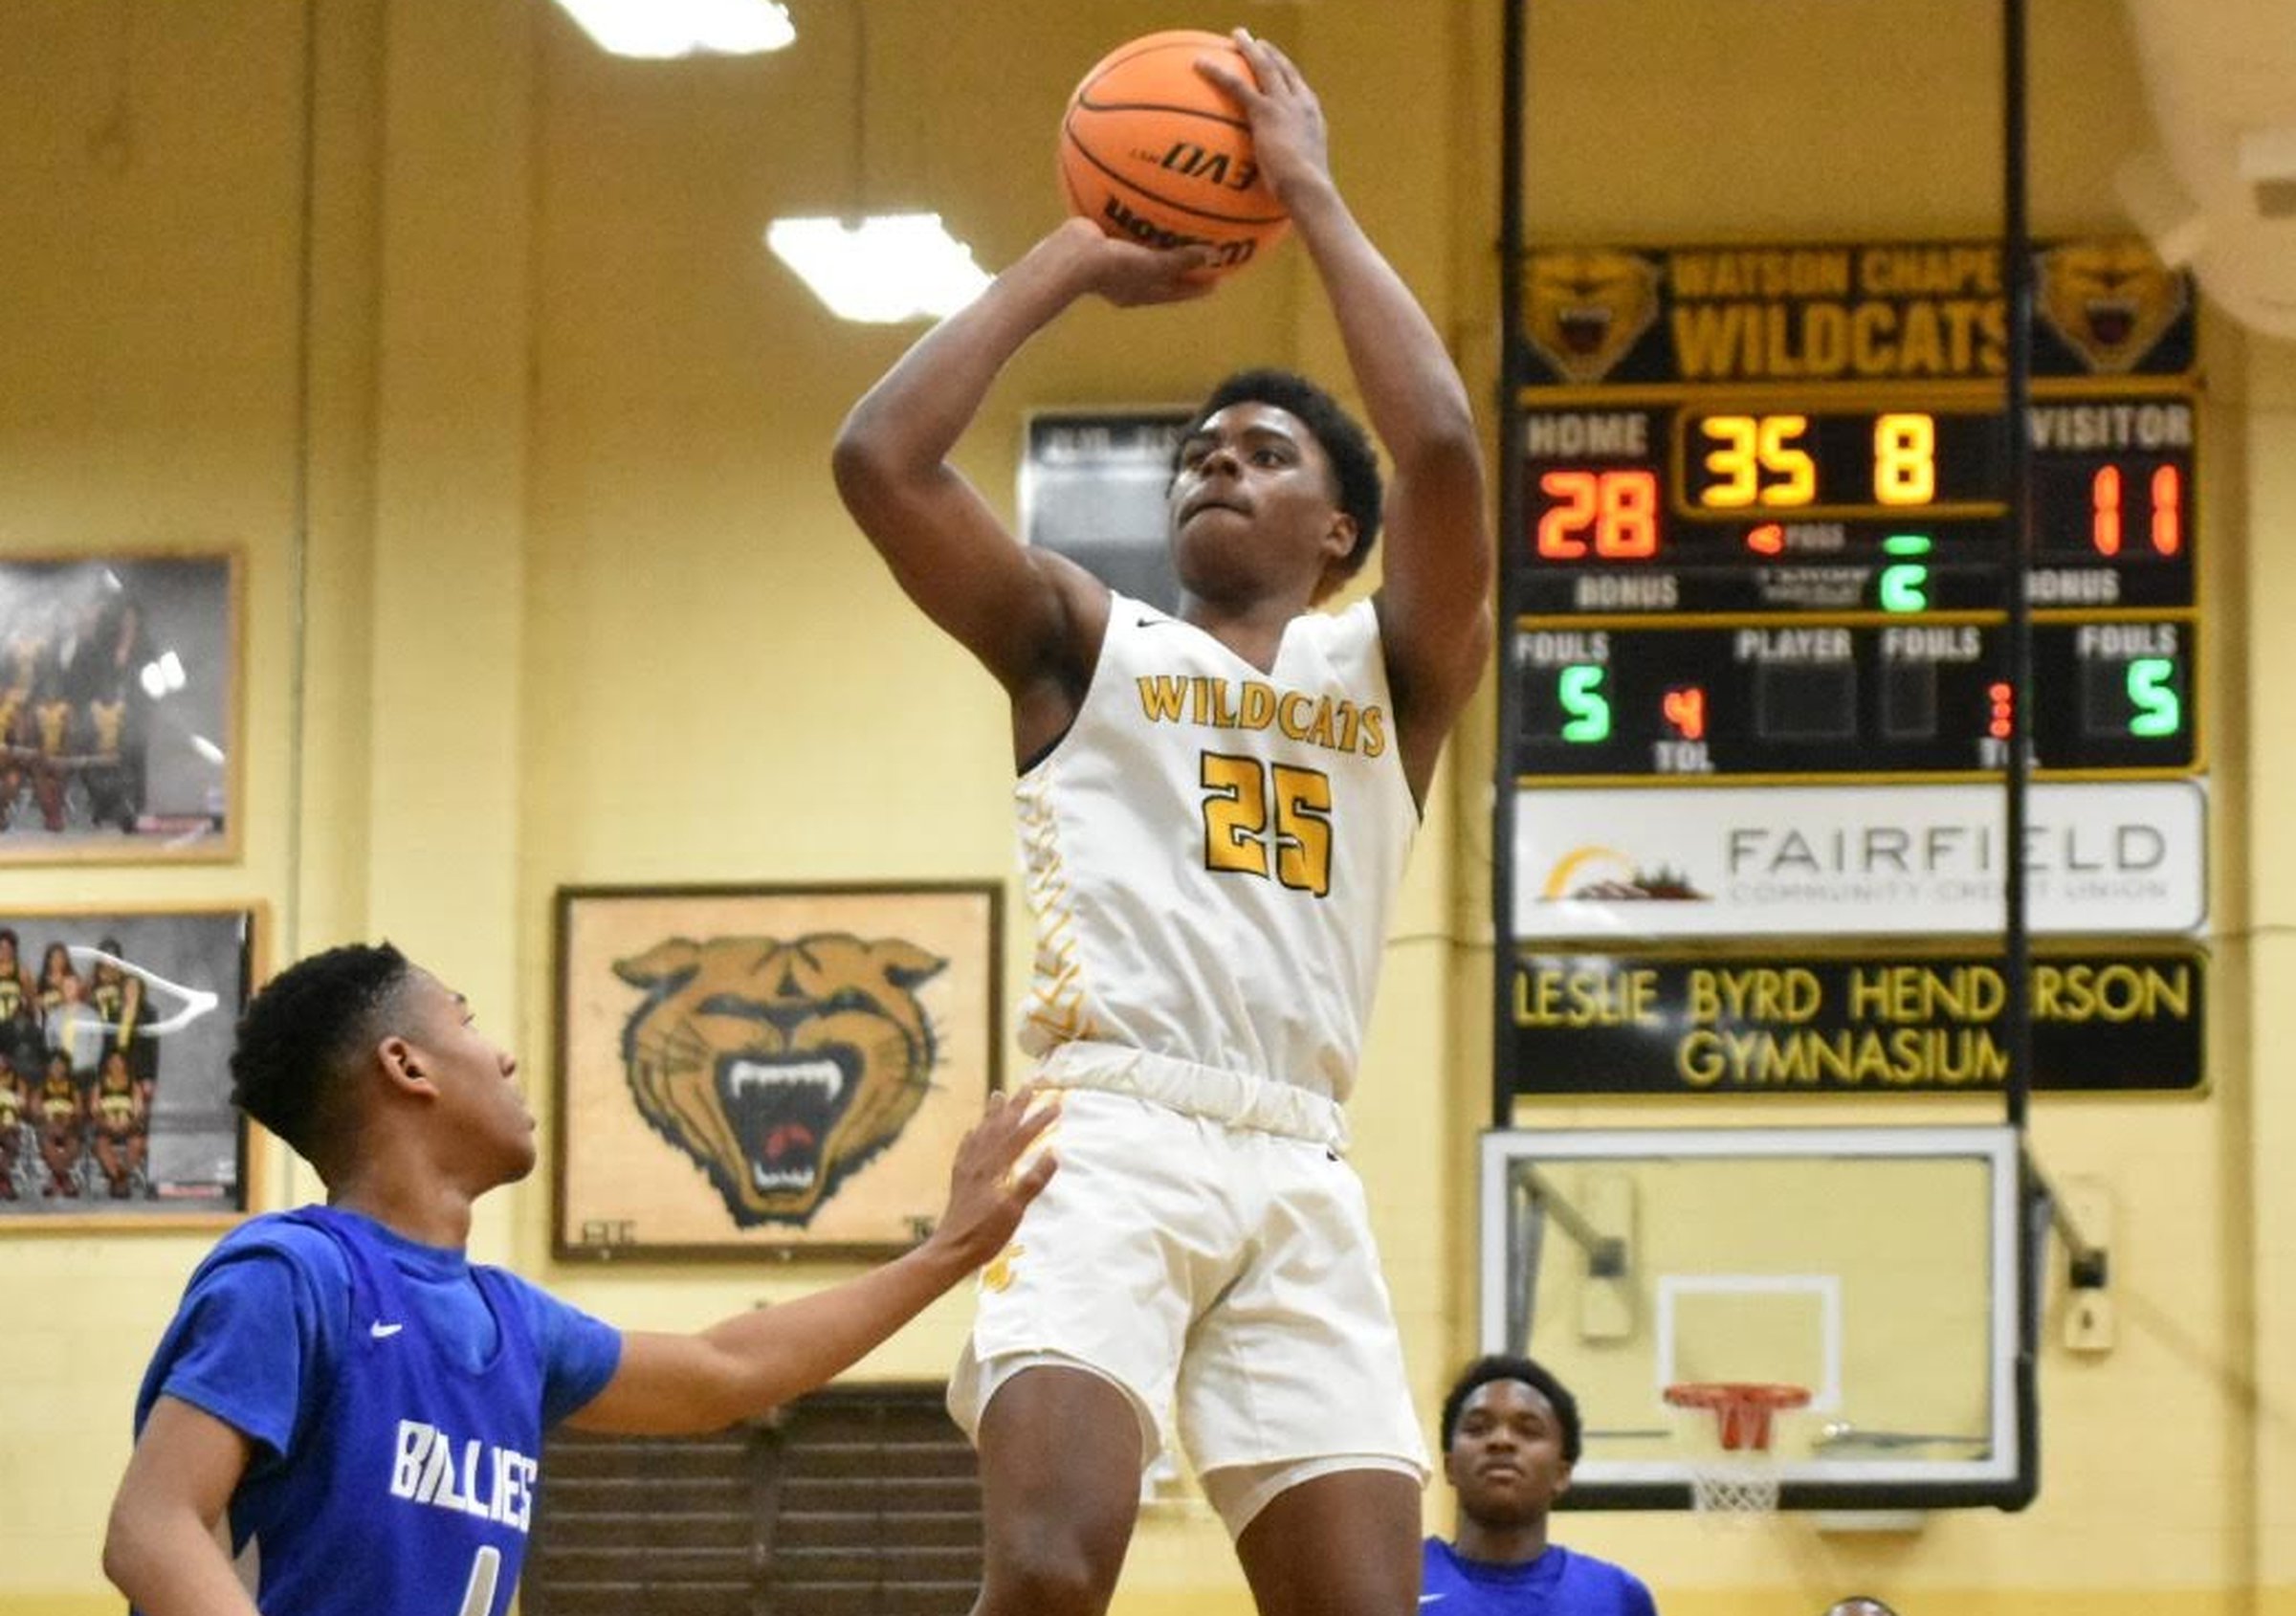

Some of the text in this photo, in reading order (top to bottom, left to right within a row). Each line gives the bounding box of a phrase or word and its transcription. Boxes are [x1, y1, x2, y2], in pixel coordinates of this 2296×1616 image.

[1674, 247, 2003, 295] WATSON CHAPE
[1674, 299, 2007, 376] WILDCATS
[1528, 413, 1648, 457] HOME
[2028, 405, 2193, 452] VISITOR
[1537, 470, 1657, 559] 28
[1575, 574, 1679, 611] BONUS
[1514, 631, 1610, 664] FOULS
[1734, 628, 1853, 661] PLAYER
[1882, 626, 1981, 660] FOULS
[2077, 625, 2178, 658] FOULS
[1137, 674, 1387, 761] WILDCATS
[1559, 665, 1611, 743] 5
[2126, 658, 2179, 737] 5
[1200, 749, 1333, 898] 25
[1729, 824, 2168, 874] FAIRFIELD
[1512, 964, 2191, 1029] LESLIE BYRD HENDRSON
[390, 1418, 539, 1534] BILLIES
